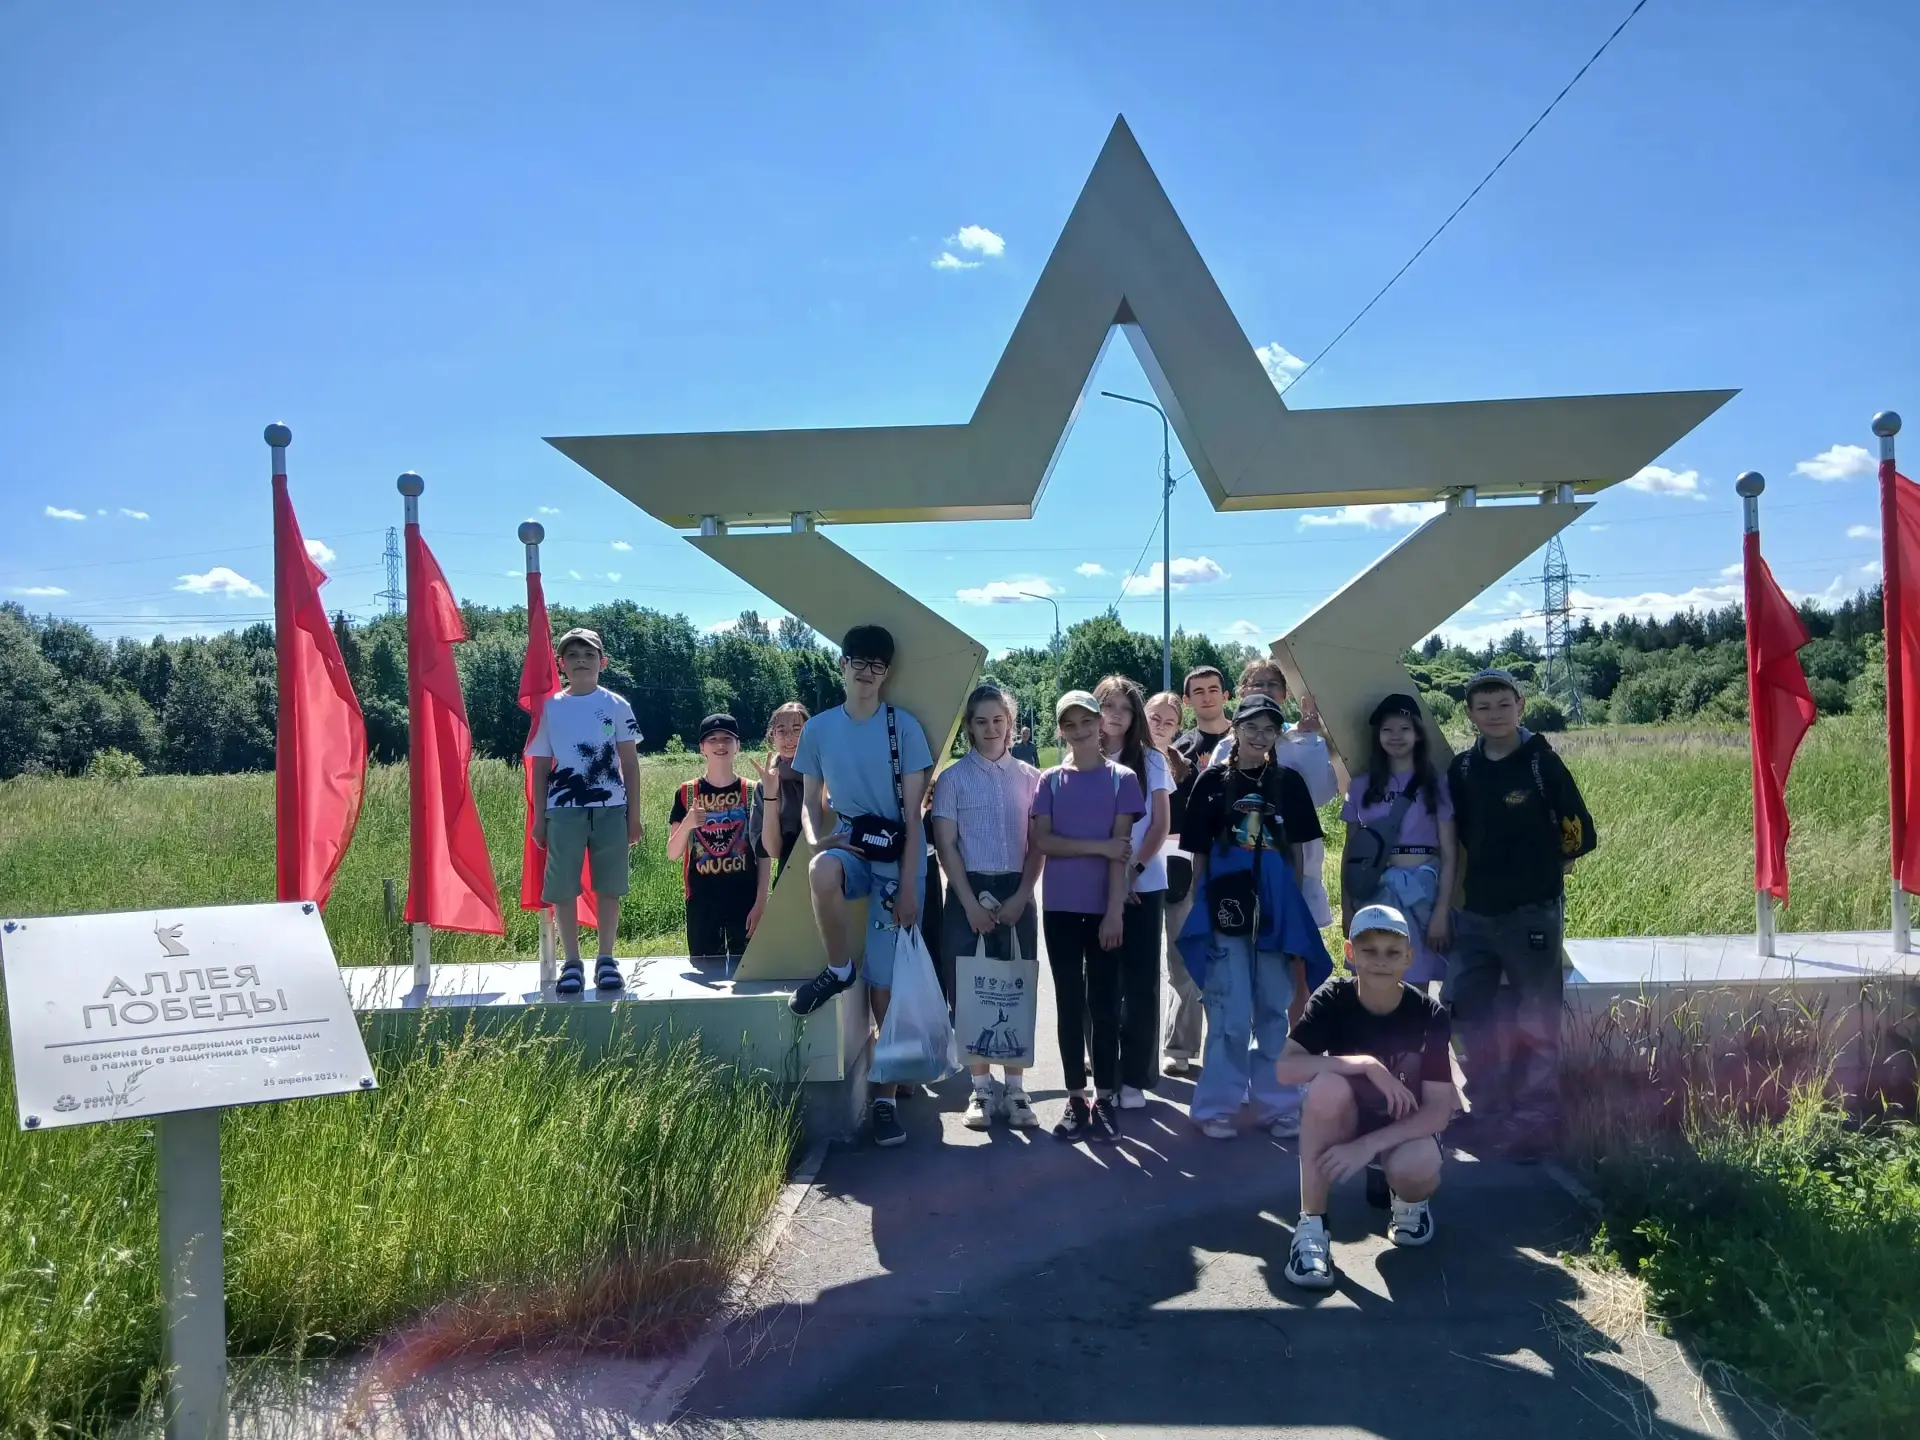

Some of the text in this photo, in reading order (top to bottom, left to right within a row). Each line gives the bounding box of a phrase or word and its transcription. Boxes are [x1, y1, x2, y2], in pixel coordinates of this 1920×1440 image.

[698, 791, 742, 808] HUGGY
[862, 833, 889, 848] PUMA
[696, 854, 746, 875] WUGGY
[102, 964, 261, 999] АЛЛЕЯ
[82, 988, 288, 1029] ПОБЕДЫ
[62, 1031, 320, 1064] Высажена благодарными потомками
[90, 1064, 98, 1072] в
[102, 1059, 152, 1071] память
[169, 1048, 249, 1063] защитниках
[251, 1043, 301, 1055] Родины
[278, 1075, 313, 1086] апреля
